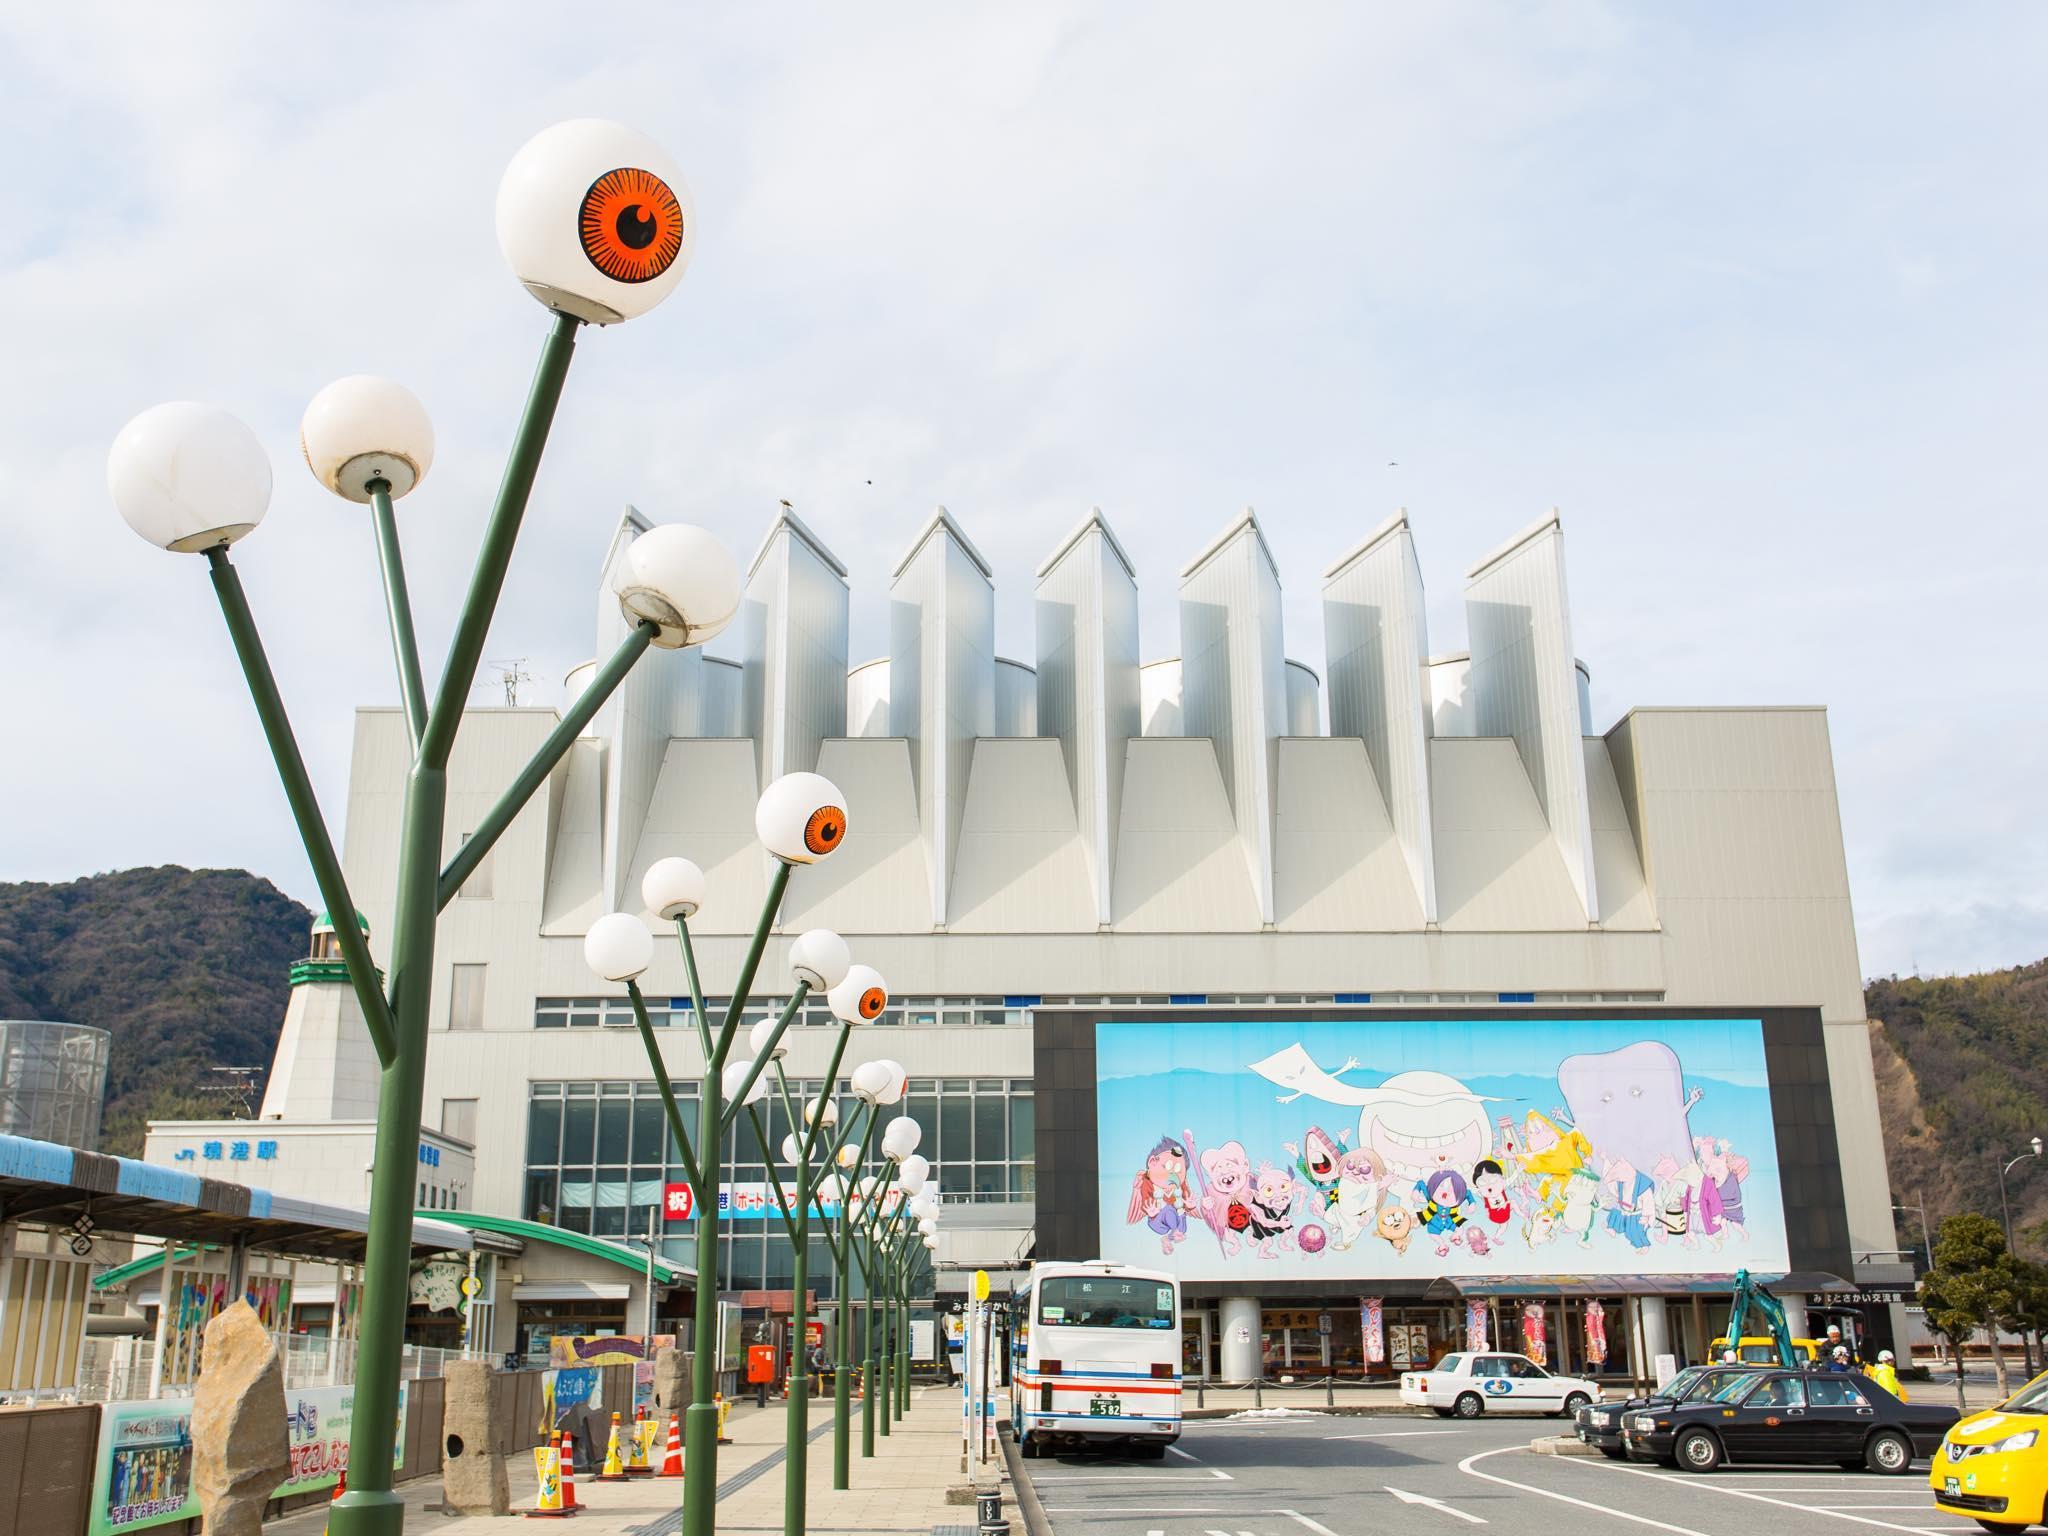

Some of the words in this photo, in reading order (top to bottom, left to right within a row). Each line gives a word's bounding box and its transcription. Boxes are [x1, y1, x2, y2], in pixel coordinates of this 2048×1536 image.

[203, 1141, 277, 1160] 境港駅
[668, 1191, 688, 1211] 祝
